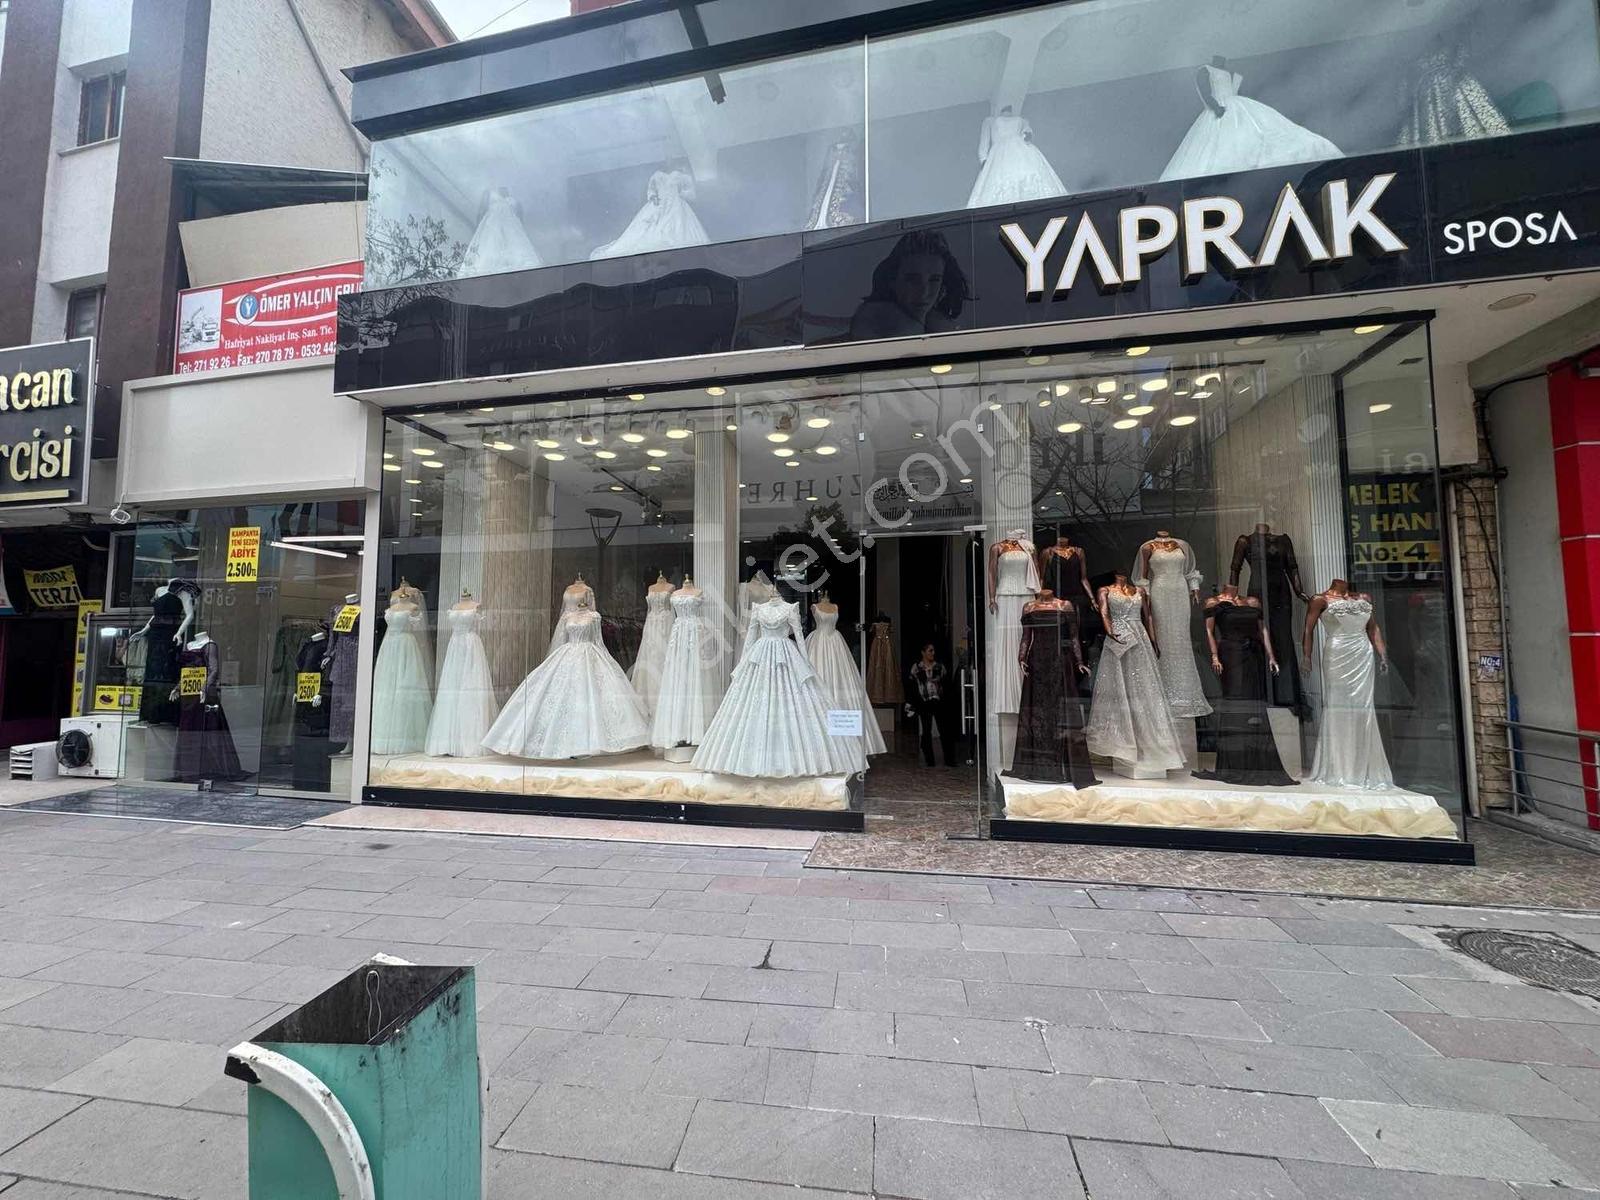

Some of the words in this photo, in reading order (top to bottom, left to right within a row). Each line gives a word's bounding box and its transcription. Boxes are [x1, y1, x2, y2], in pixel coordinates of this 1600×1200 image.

[1000, 171, 1409, 300] YAPRAK
[1443, 210, 1578, 255] SPOSA
[259, 294, 291, 313] ÖMER
[293, 286, 333, 309] YALÇIN
[224, 334, 254, 350] Hafriyat
[255, 332, 285, 346] Nakliyat
[302, 327, 318, 338] San.
[320, 324, 334, 336] Tic.
[178, 362, 193, 374] Tel:
[194, 359, 208, 372] 271
[209, 357, 219, 370] 92
[220, 356, 231, 369] 26
[237, 352, 254, 367] Fax:
[255, 349, 270, 364] 270
[272, 348, 282, 361] 78
[283, 346, 294, 360] 79
[301, 343, 321, 357] 0532
[31, 581, 81, 605] TERZİ
[183, 679, 202, 693] 2500
